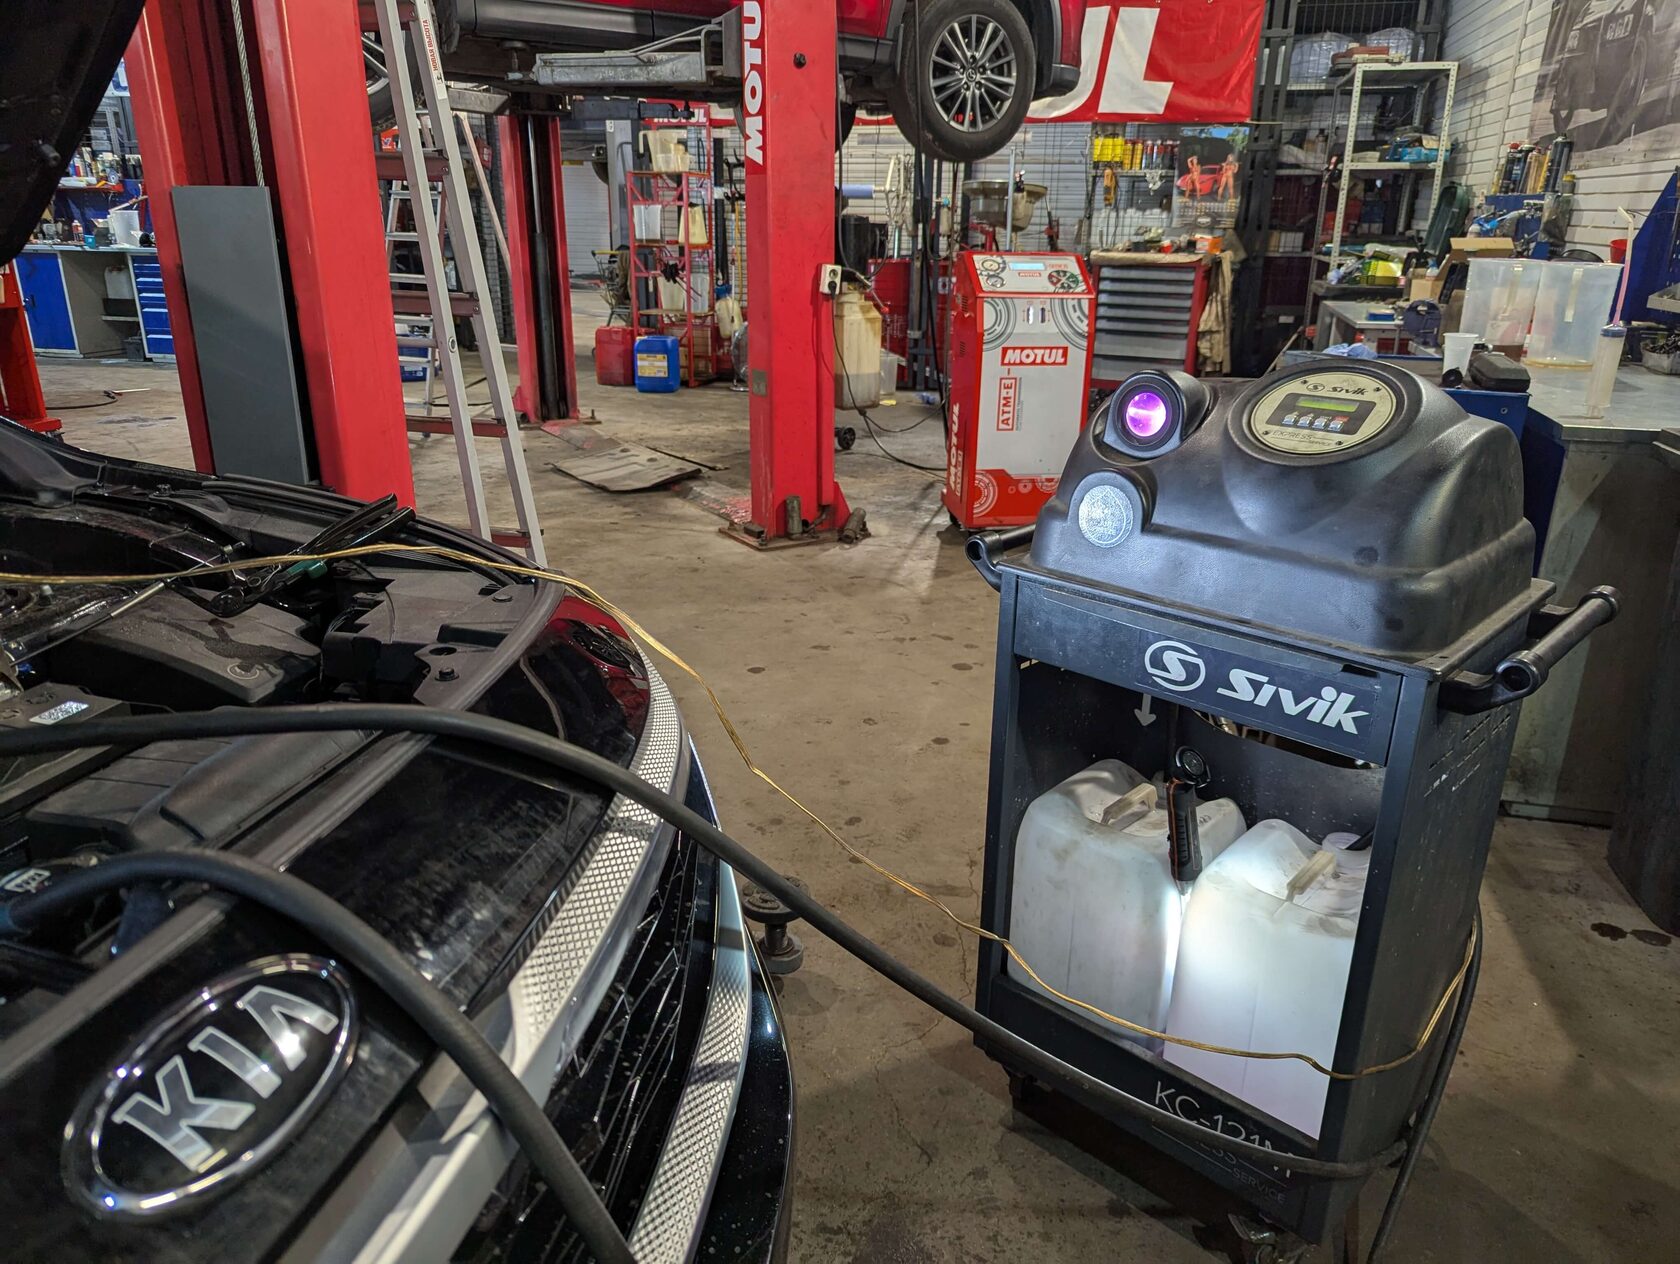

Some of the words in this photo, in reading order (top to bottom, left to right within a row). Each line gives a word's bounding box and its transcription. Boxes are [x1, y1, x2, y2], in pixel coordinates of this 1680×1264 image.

[429, 48, 438, 71] НОВАЯ
[1003, 348, 1065, 364] MOTUL
[1001, 382, 1013, 426] ATM-E
[949, 402, 960, 491] MOTUL
[112, 984, 339, 1173] KIA
[1232, 1167, 1288, 1204] SERVICE
